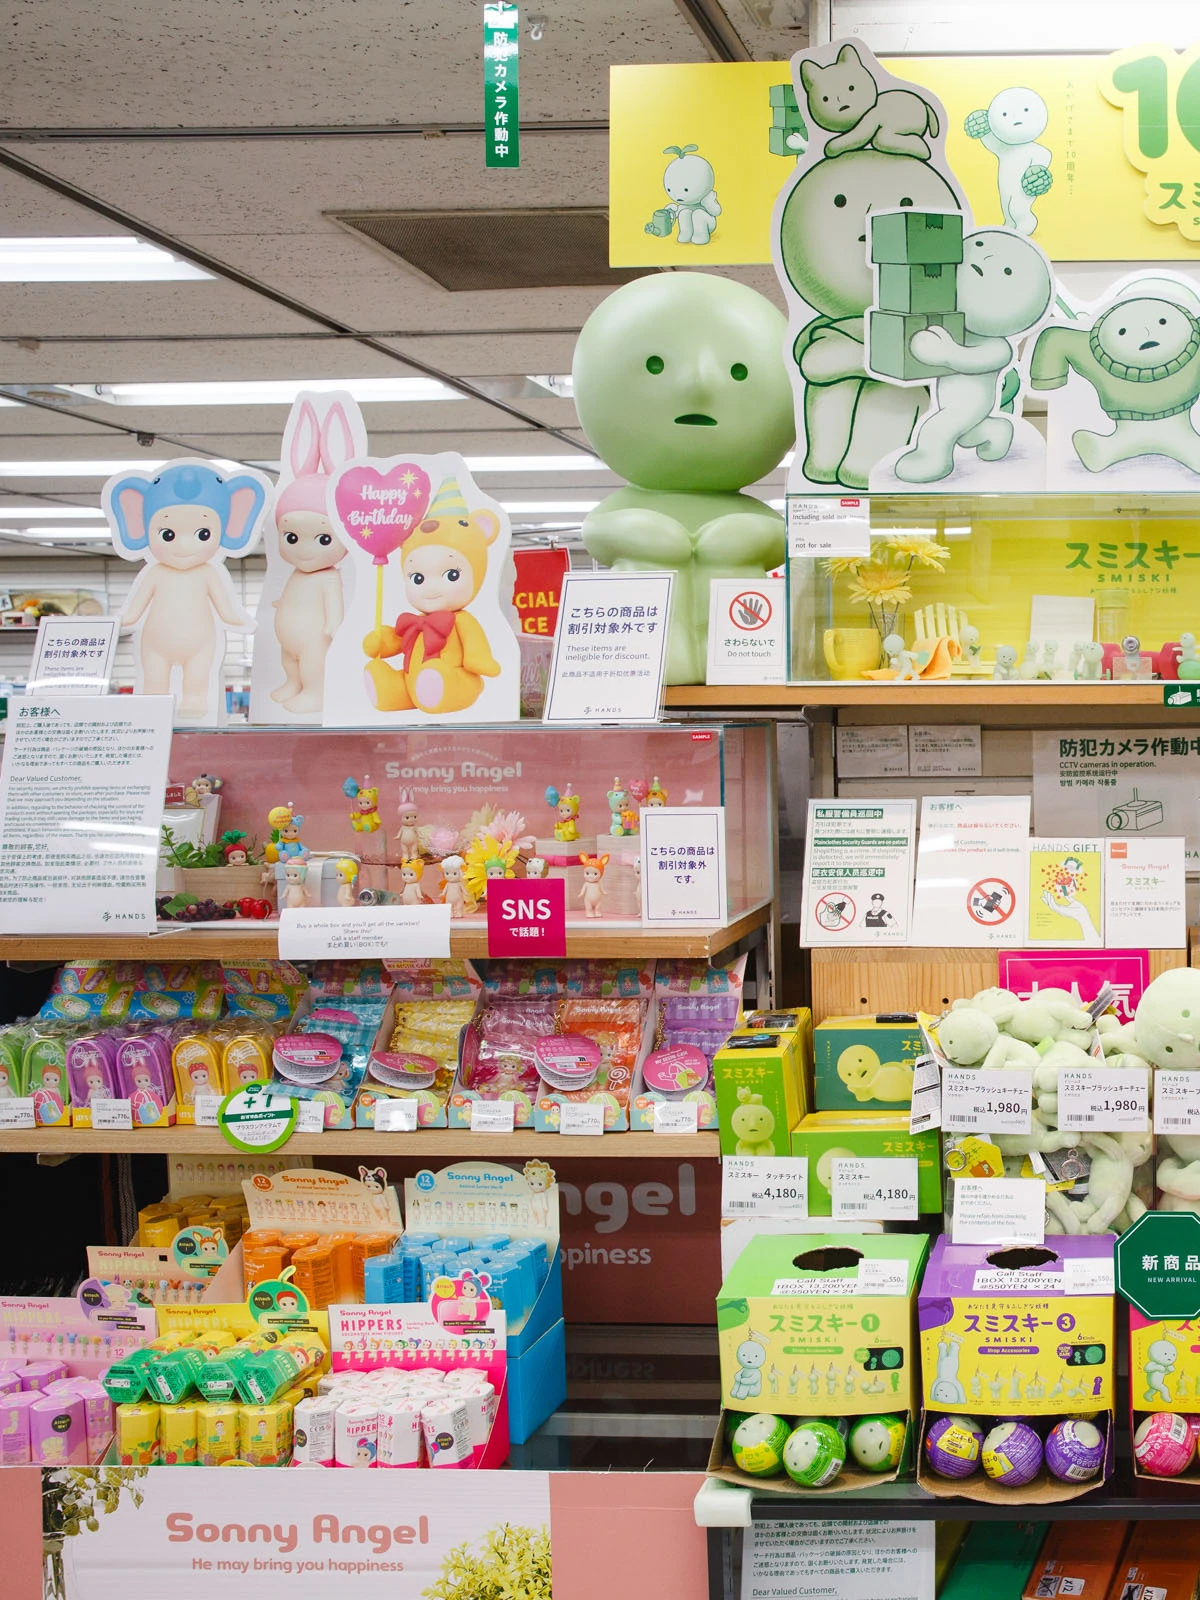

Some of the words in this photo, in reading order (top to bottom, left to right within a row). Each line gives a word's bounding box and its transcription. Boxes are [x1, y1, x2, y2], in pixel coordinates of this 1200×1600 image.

[360, 484, 408, 504] Happy
[348, 508, 413, 529] Birthday
[571, 606, 658, 618] こちらの商品は
[568, 622, 658, 634] 割引対象外です
[724, 638, 775, 647] さわらないで
[566, 653, 600, 662] ineligible
[615, 652, 650, 660] discount.
[19, 706, 61, 718] お客様へ
[1118, 761, 1156, 769] operation.
[385, 762, 454, 782] Sonny
[461, 762, 522, 782] Angel
[930, 804, 962, 812] お客様へ
[650, 846, 715, 857] こちらの商品は
[1032, 843, 1070, 852] HANDS
[1073, 844, 1098, 852] GIFT
[658, 859, 708, 871] 割引対象外
[674, 874, 696, 884] です。
[502, 899, 551, 920] SNS
[509, 926, 544, 938] で話題!
[973, 1102, 1028, 1116] 税込1,980円
[728, 1171, 759, 1179] スミスキー
[766, 1172, 804, 1180] タッチライト
[752, 1187, 804, 1200] 税込4,180円
[1142, 1254, 1200, 1271] 新商品
[1008, 1277, 1062, 1285] 13,200YEN
[341, 1319, 402, 1331] HIPPERS
[964, 1314, 1053, 1333] スミスキー
[166, 1512, 298, 1554] Sonny
[312, 1514, 428, 1554] Angel
[192, 1558, 212, 1572] He
[217, 1561, 249, 1575] may
[254, 1557, 293, 1575] bring
[297, 1561, 324, 1575] you
[328, 1557, 404, 1575] happiness
[753, 1588, 770, 1596] Dear
[772, 1588, 797, 1596] Valued
[799, 1587, 837, 1596] Customer,
